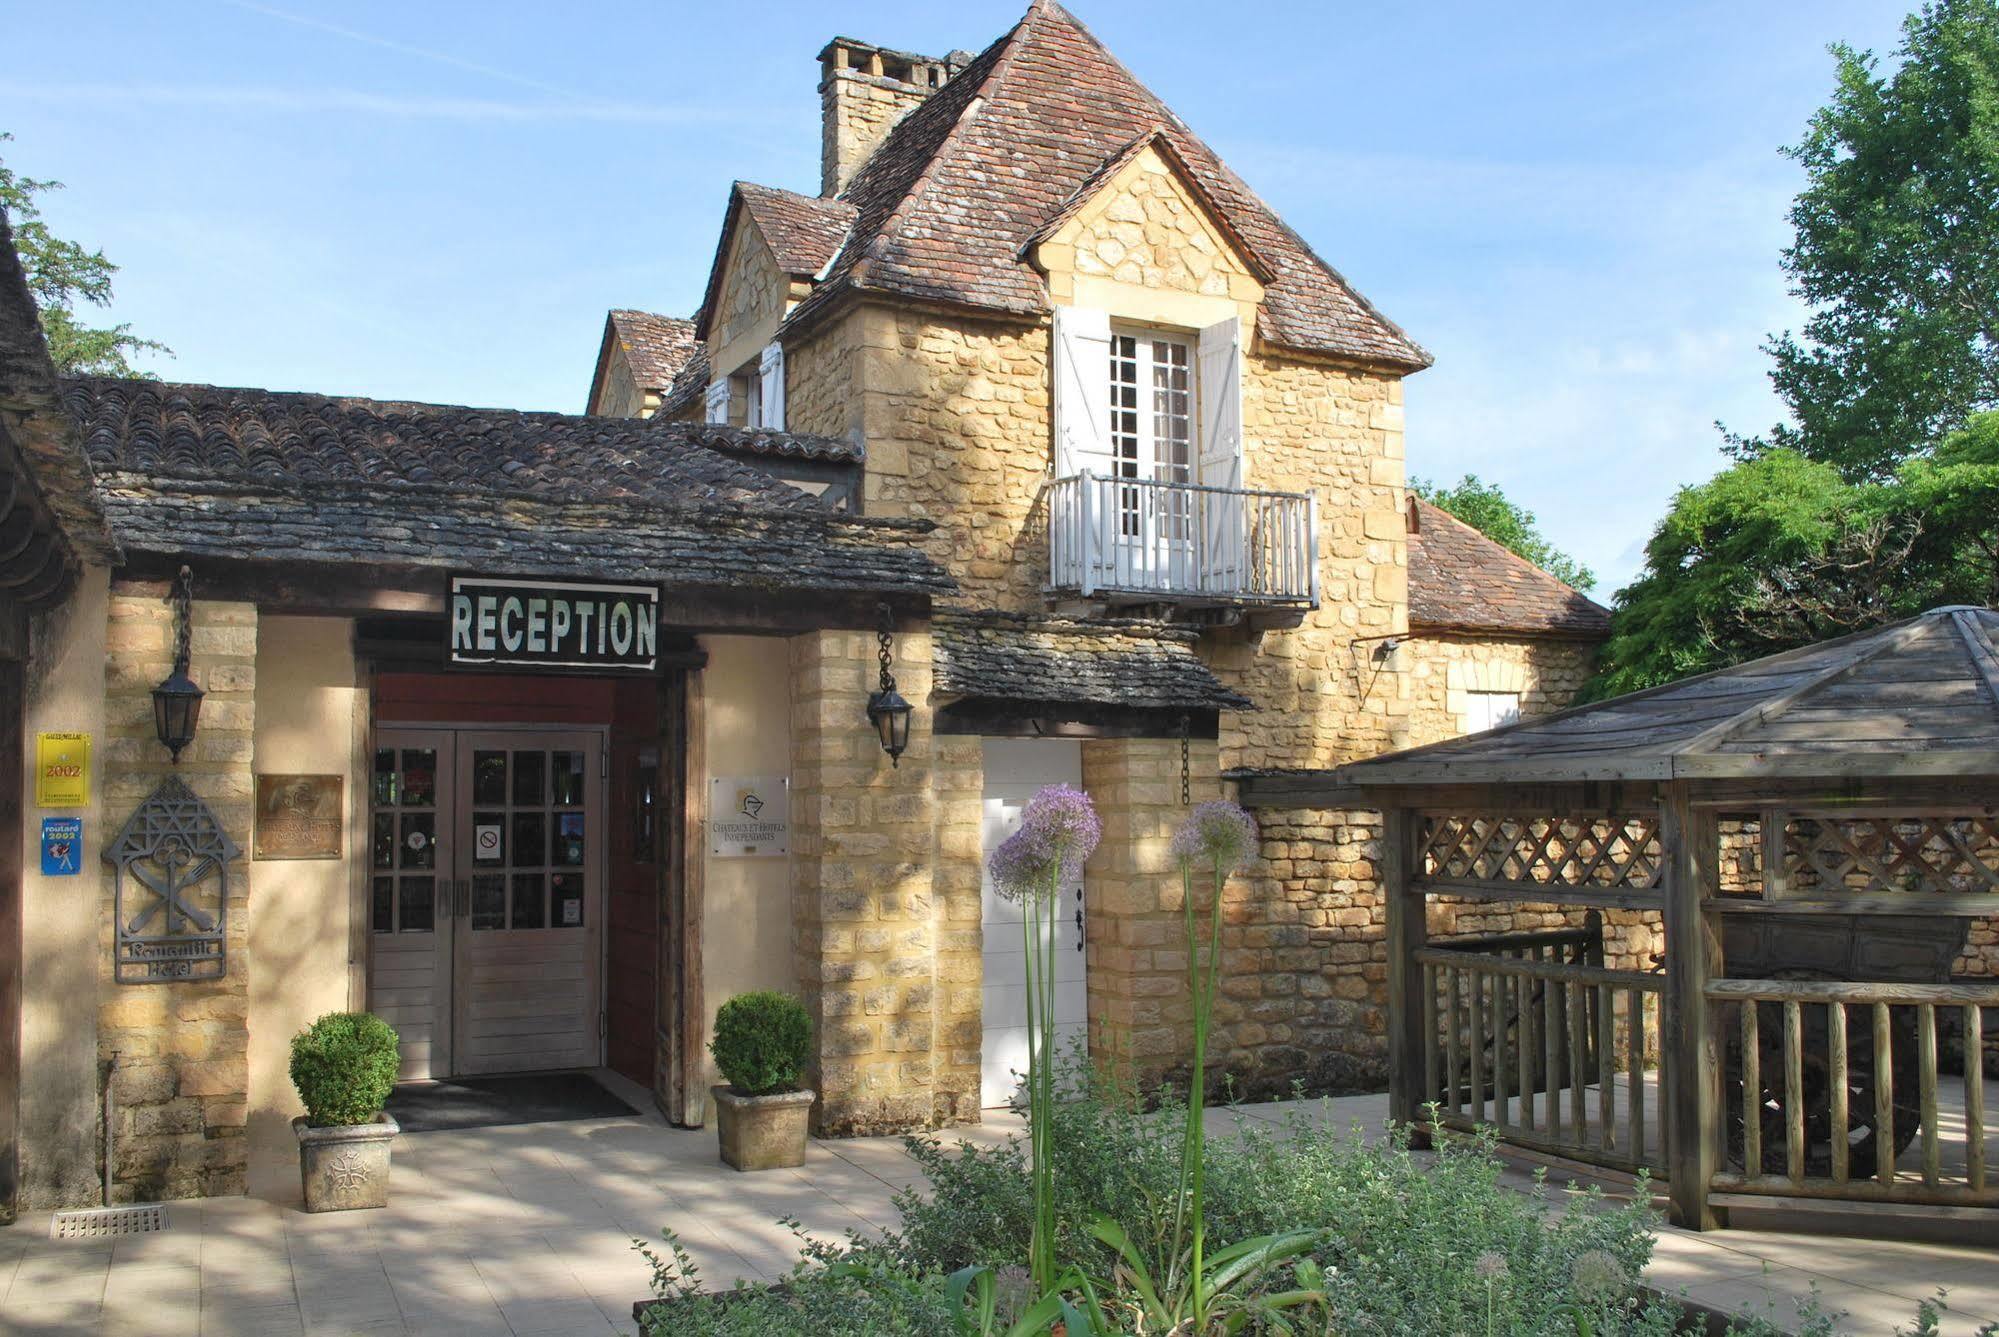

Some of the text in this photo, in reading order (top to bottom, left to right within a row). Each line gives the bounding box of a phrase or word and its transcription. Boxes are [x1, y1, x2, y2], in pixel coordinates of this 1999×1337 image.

[452, 595, 656, 656] RECEPTION
[46, 765, 81, 777] 2002
[45, 824, 79, 833] routard
[48, 832, 76, 840] 2002
